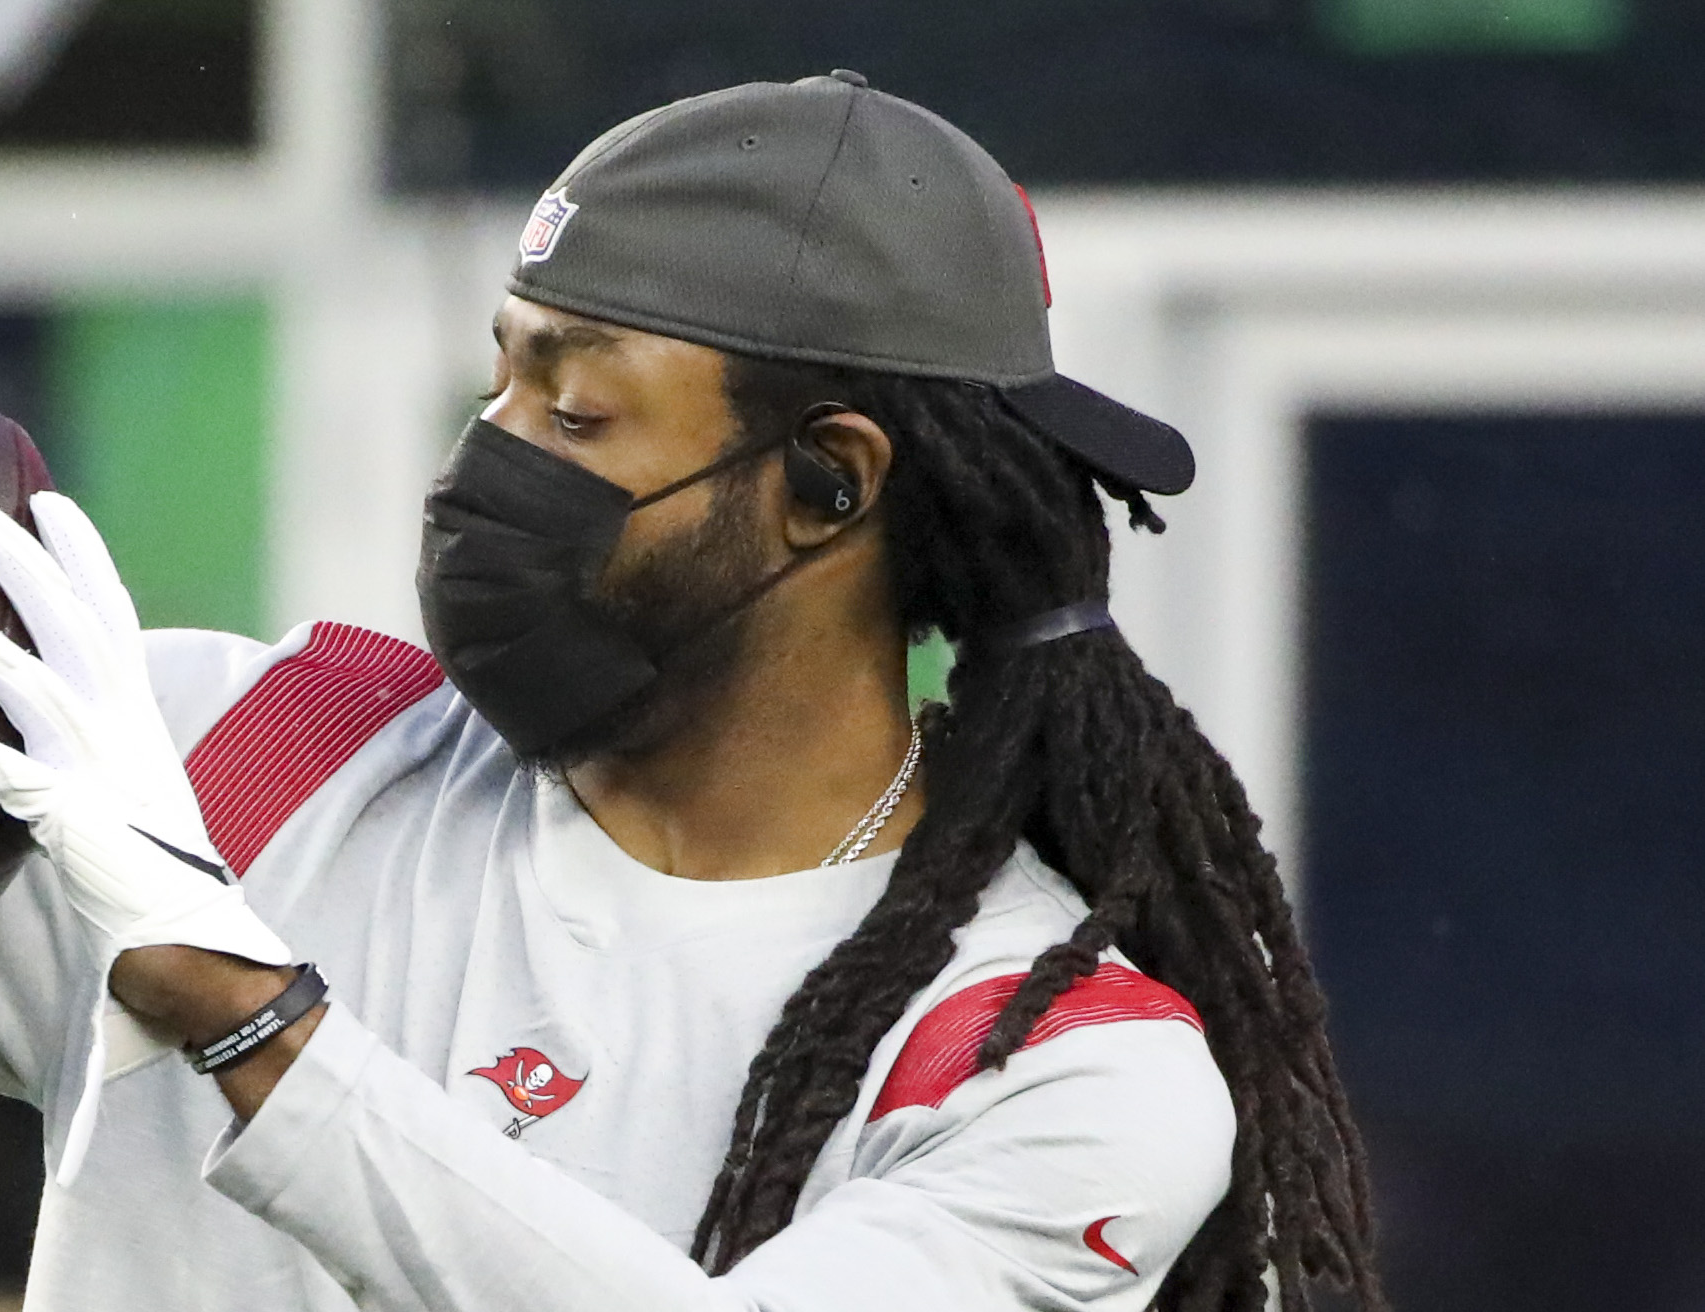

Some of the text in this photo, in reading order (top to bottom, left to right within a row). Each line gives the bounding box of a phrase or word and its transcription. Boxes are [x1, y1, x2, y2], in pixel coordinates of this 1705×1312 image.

[254, 1009, 276, 1027] HOPE
[239, 1022, 257, 1037] FOR
[235, 1034, 259, 1052] FROM
